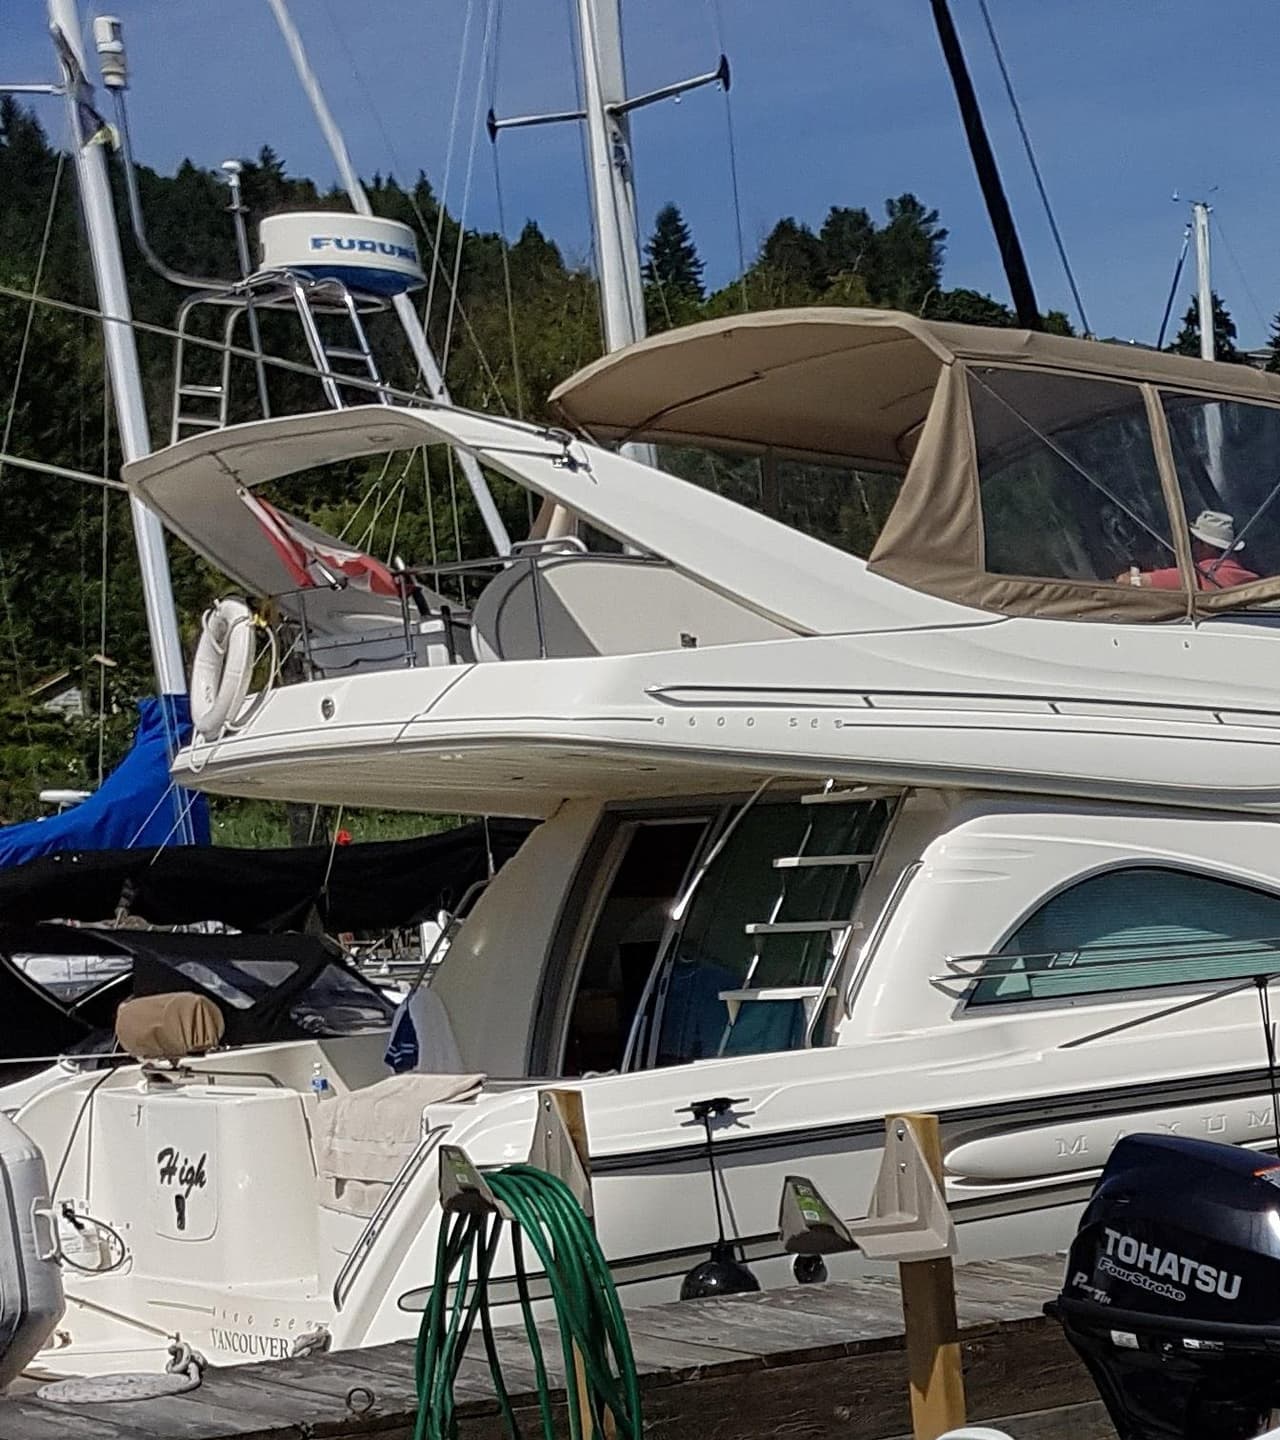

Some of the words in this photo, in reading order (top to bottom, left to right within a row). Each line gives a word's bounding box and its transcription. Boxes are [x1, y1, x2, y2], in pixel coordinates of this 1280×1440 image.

[310, 236, 417, 264] FURUN
[157, 1146, 208, 1200] High
[1098, 1256, 1187, 1302] FourStroke
[1104, 1226, 1243, 1300] TOHATSU
[210, 1327, 291, 1358] VANCOUVER
